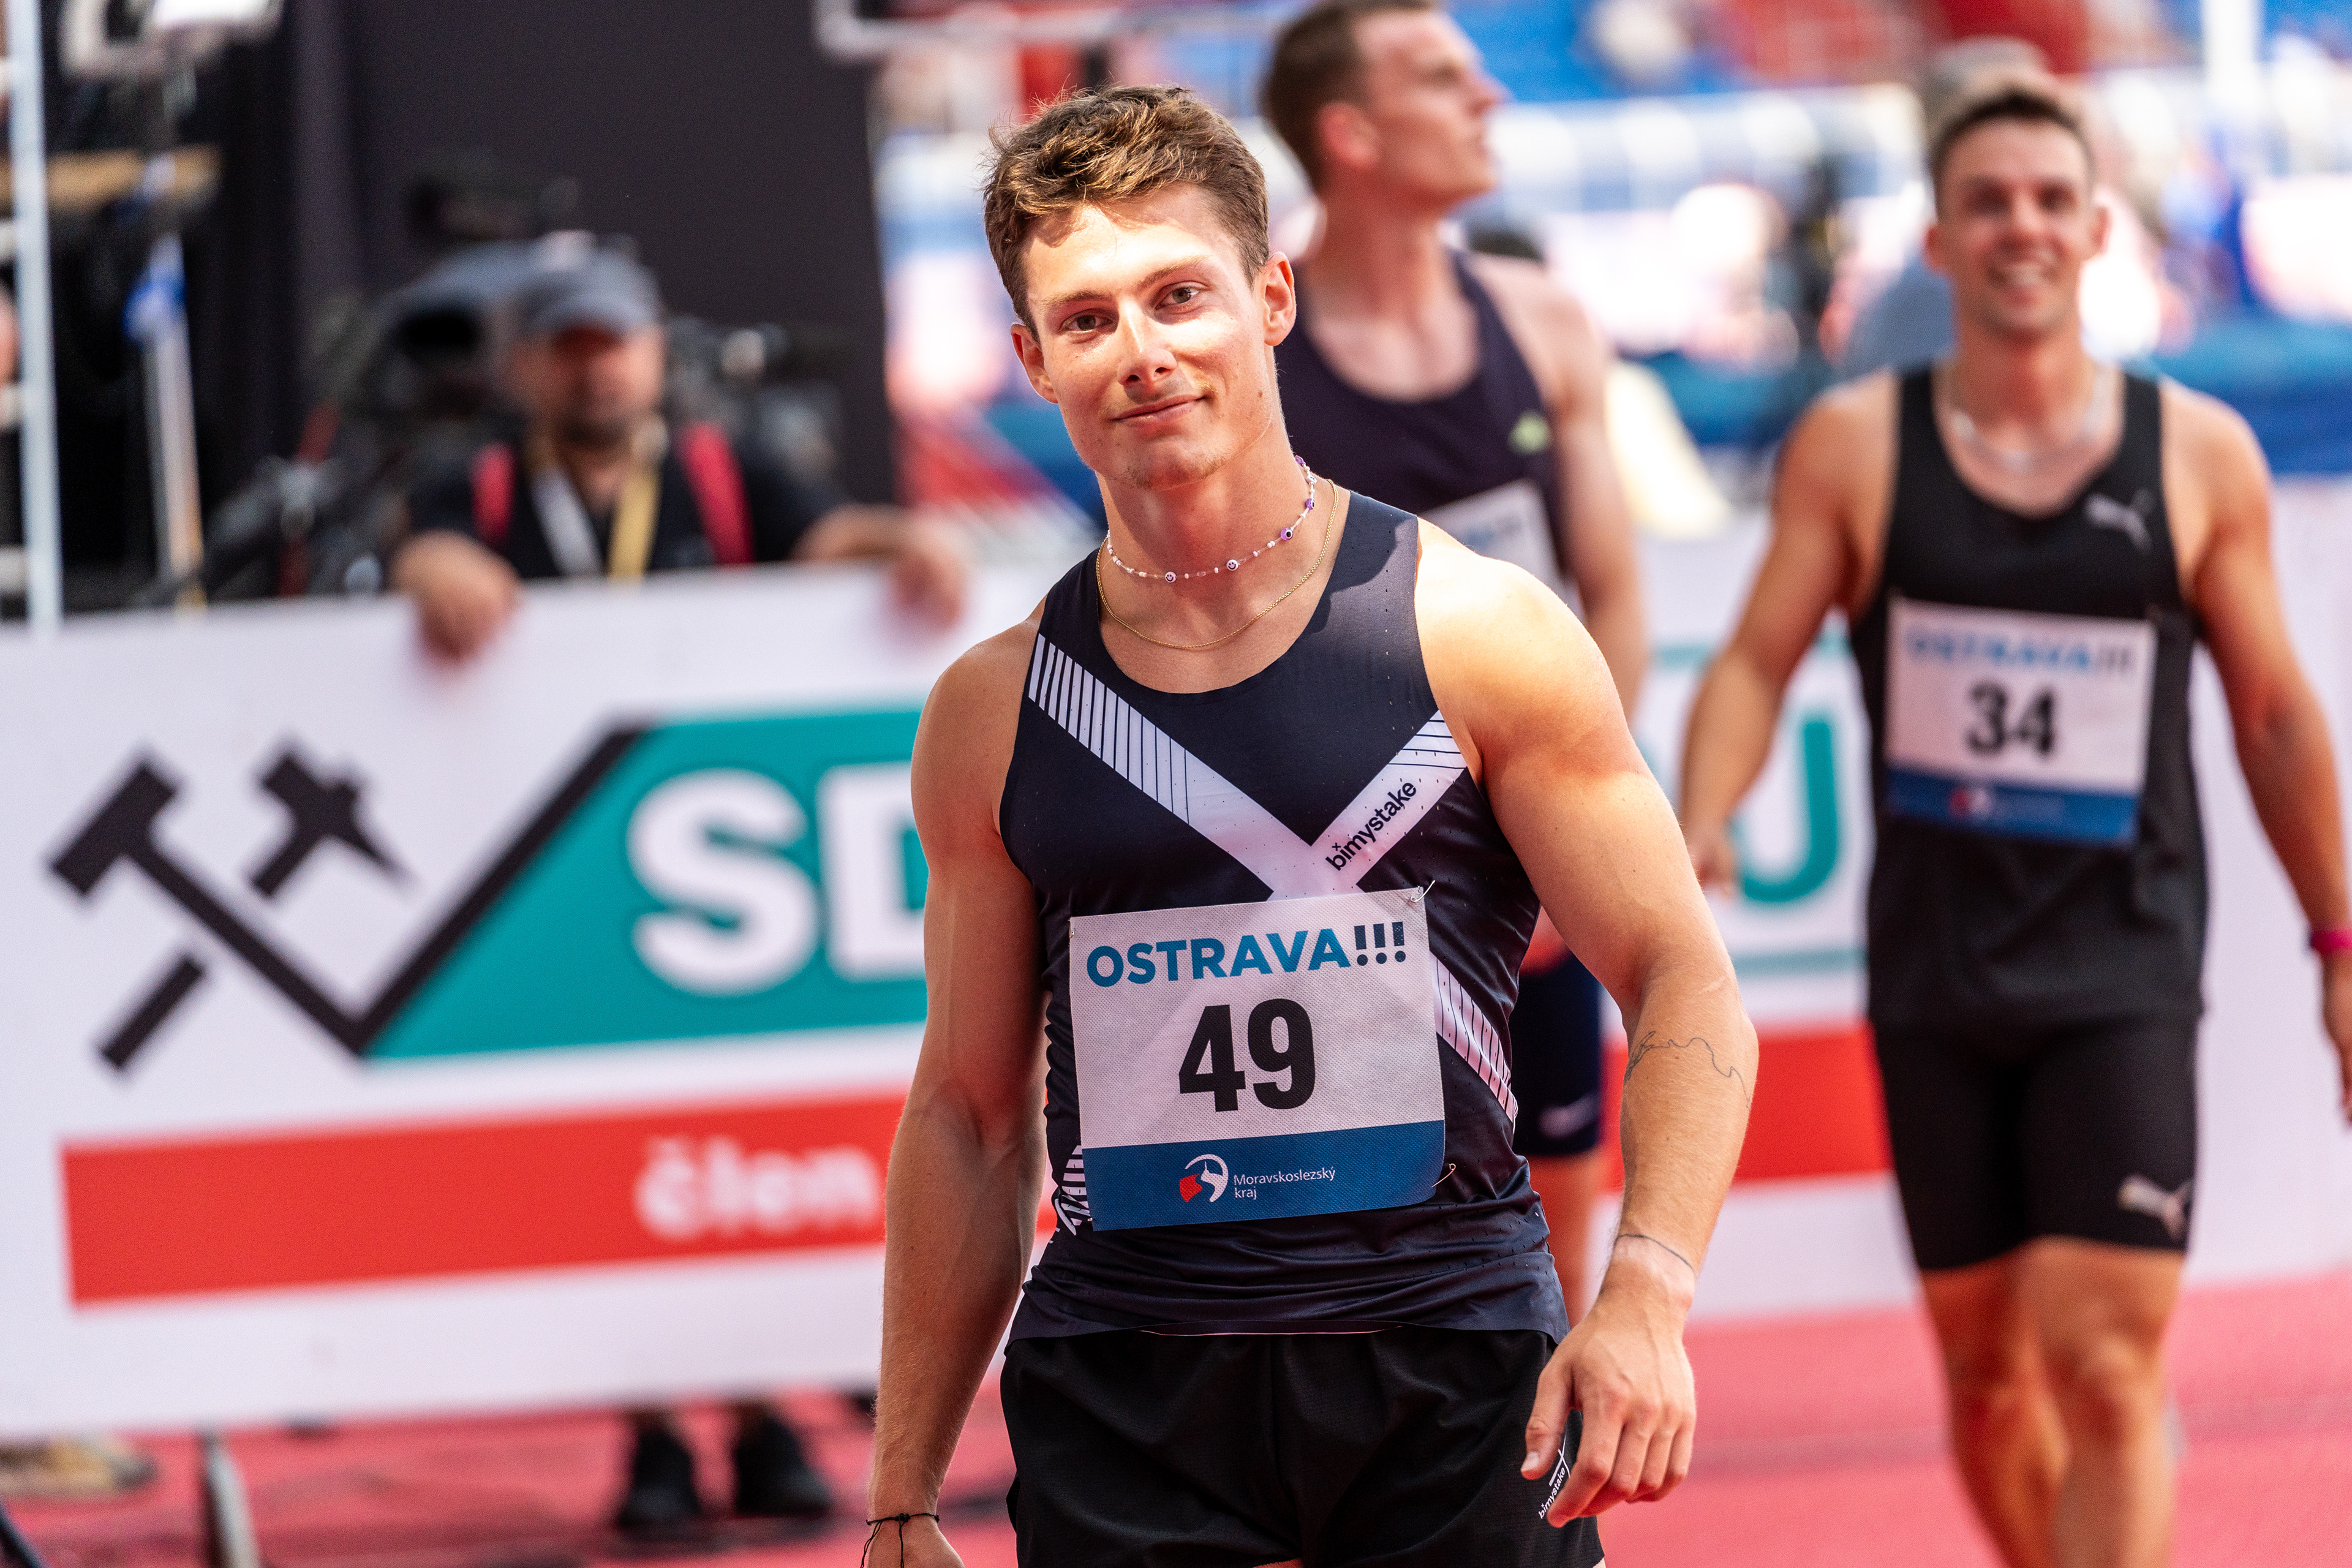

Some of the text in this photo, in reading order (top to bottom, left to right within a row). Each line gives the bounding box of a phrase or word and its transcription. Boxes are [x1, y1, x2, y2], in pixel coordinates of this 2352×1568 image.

[1966, 677, 2056, 761] 34
[1325, 782, 1417, 871] bimystake
[1087, 921, 1407, 988] OSTRAVA!!!
[1178, 998, 1317, 1113] 49
[1233, 1166, 1336, 1187] Moravskoslezský
[1234, 1186, 1257, 1200] kraj
